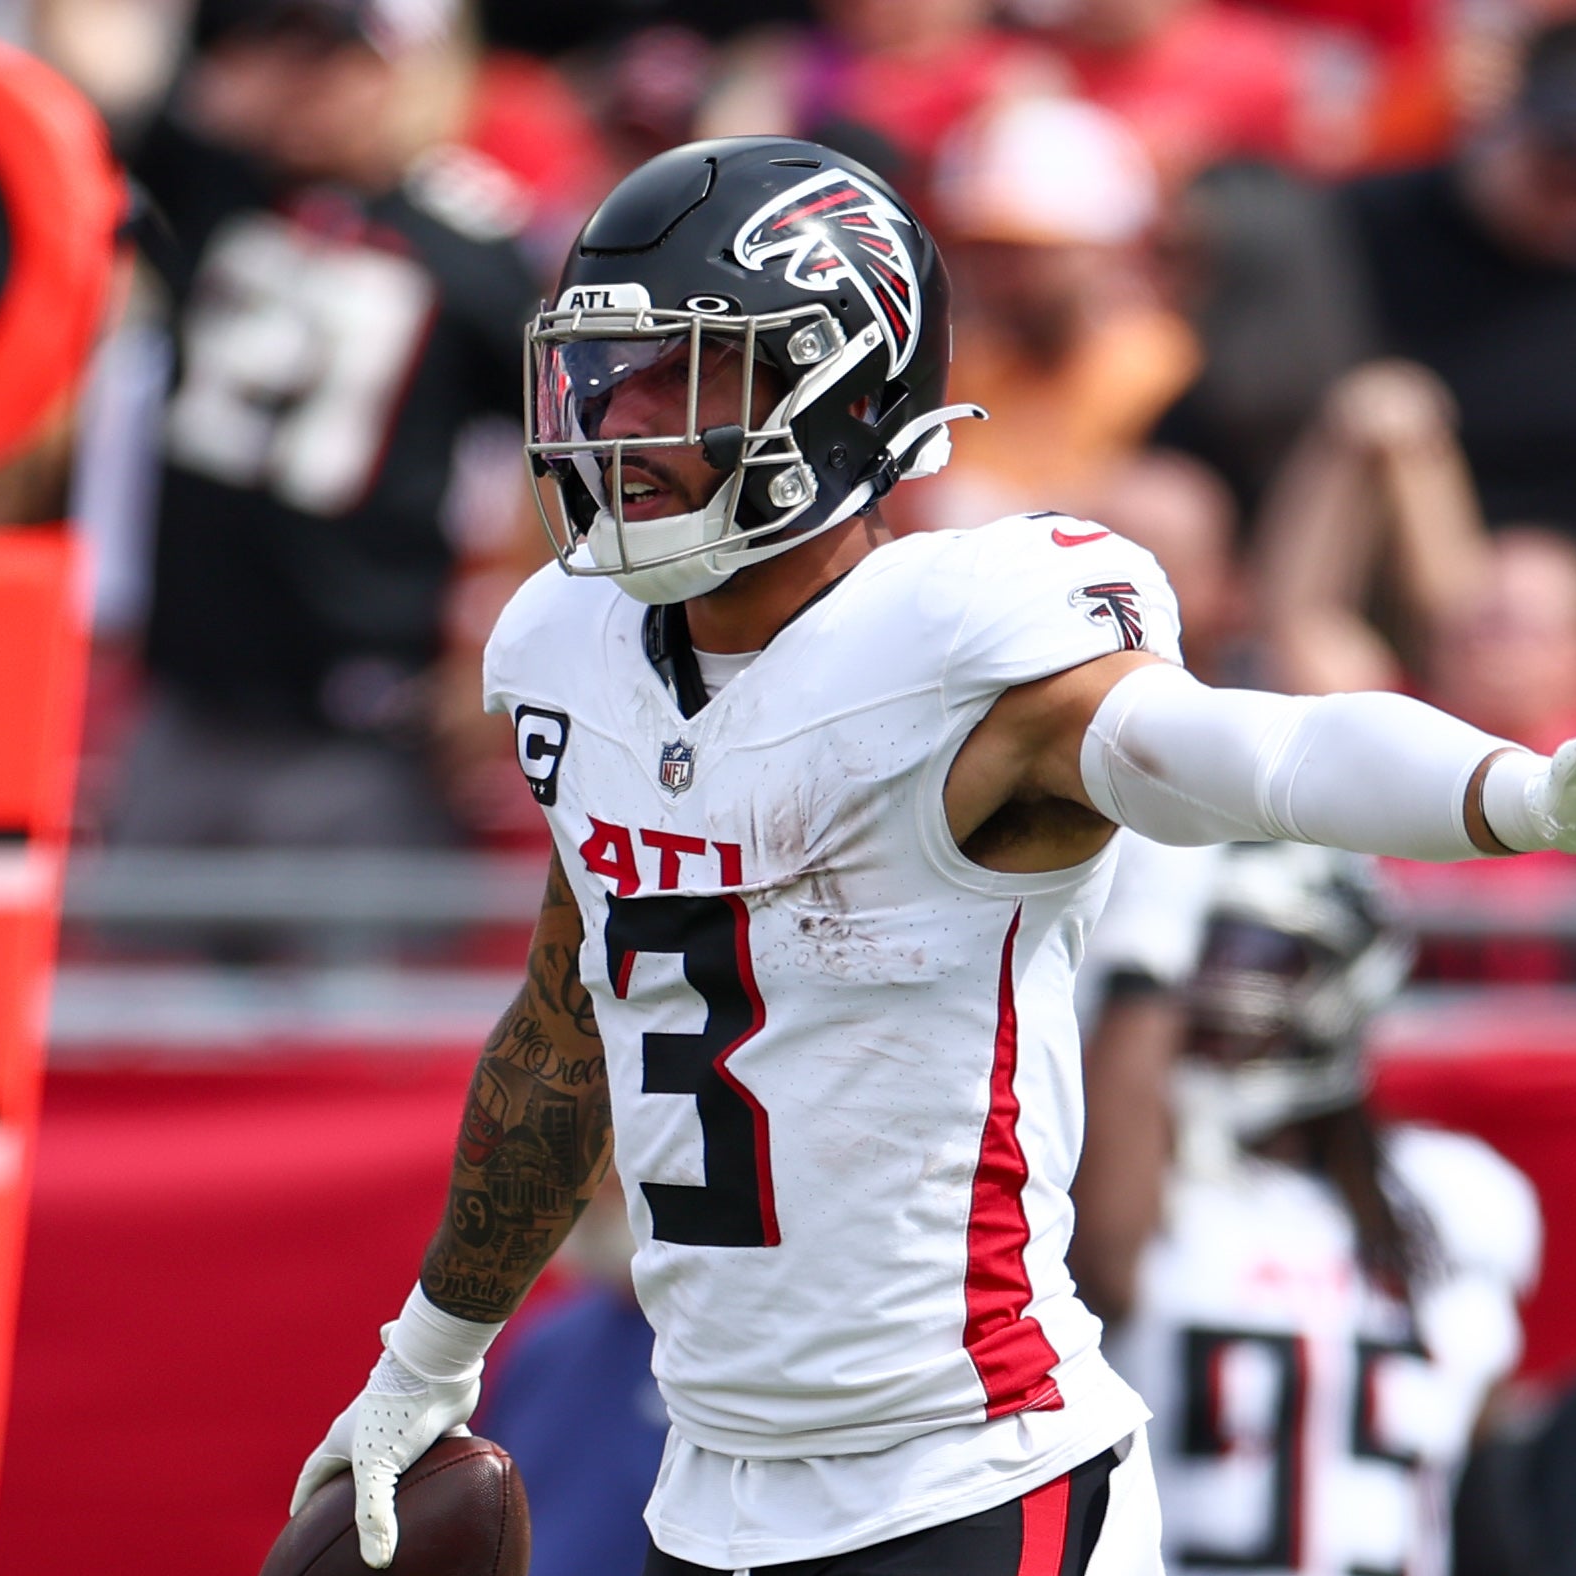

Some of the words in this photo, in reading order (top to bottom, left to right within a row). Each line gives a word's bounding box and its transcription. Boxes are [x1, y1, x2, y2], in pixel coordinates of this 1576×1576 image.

[569, 291, 615, 310] ATL
[517, 714, 563, 780] C
[662, 762, 688, 786] NFL
[605, 892, 781, 1248] 3
